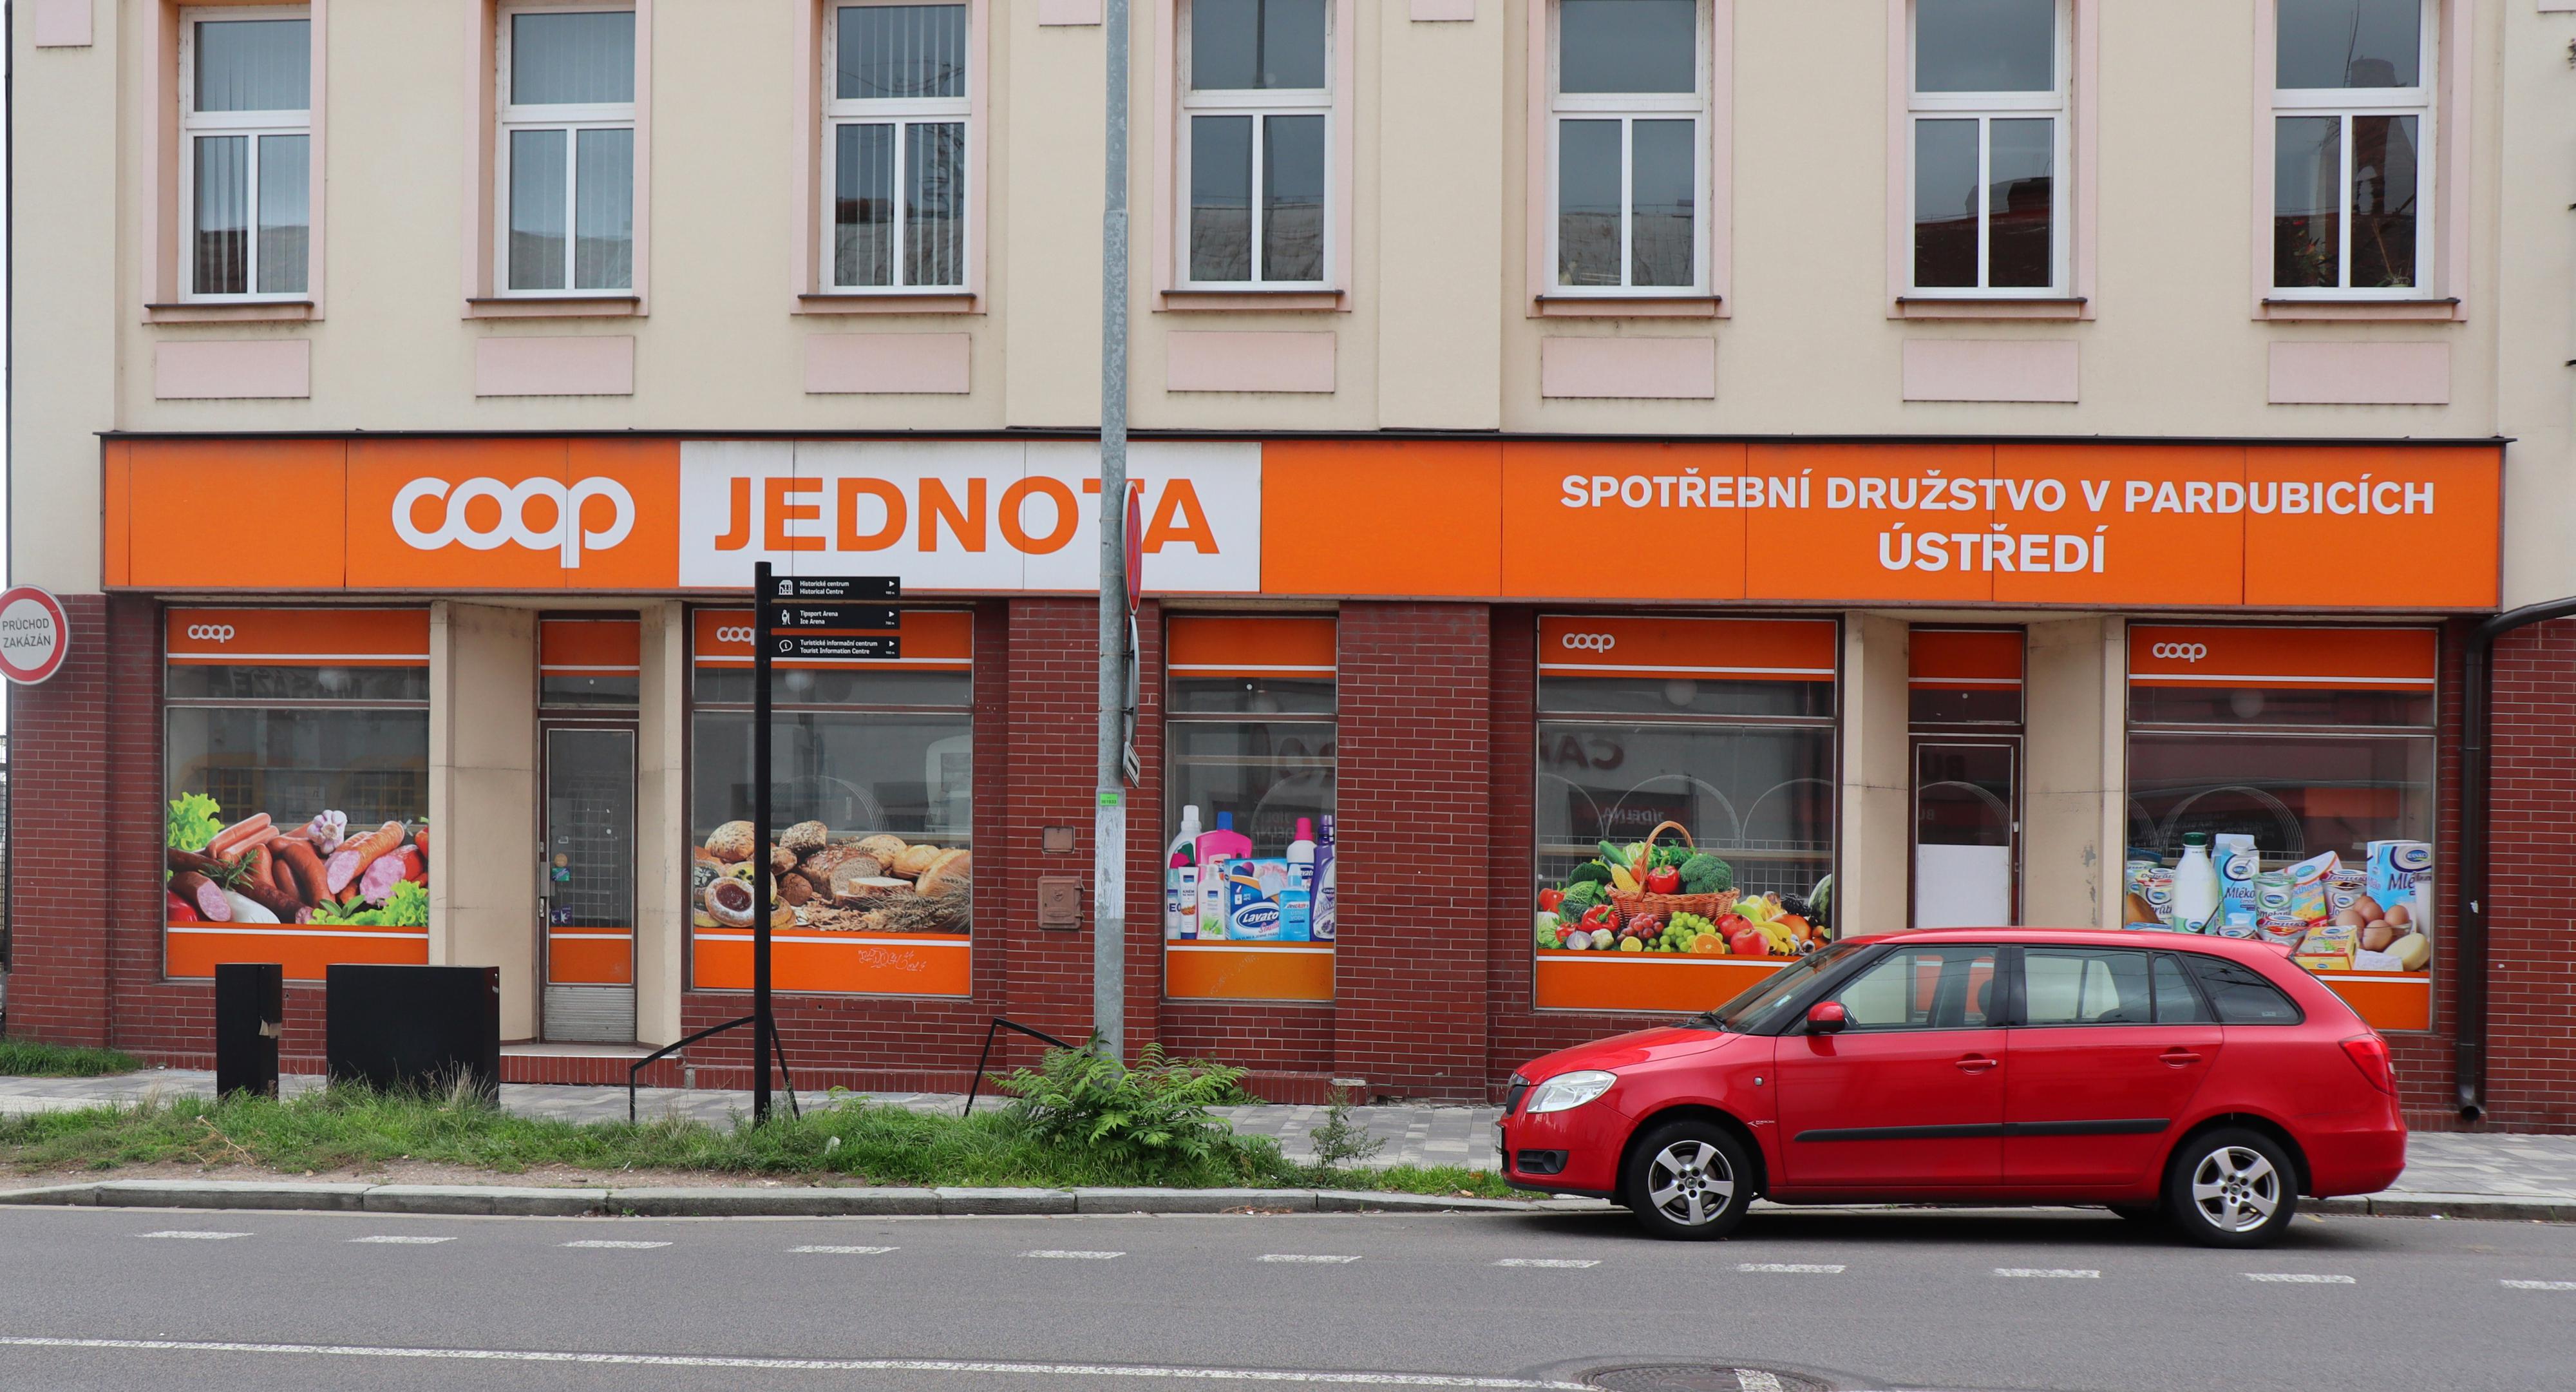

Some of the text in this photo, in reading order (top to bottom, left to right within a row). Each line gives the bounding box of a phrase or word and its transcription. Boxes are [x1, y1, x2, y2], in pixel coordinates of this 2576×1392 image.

[1560, 468, 2434, 515] SPOTŘEBNÍ DRUŽSTVO V PARDUBICÍCH
[392, 477, 636, 568] coop
[1879, 522, 2108, 573] ÚSTŘEDÍ
[3, 618, 50, 631] PRŮCHOD
[187, 624, 235, 643] coop
[3, 633, 52, 648] ZAKÁZÁN
[1562, 633, 1615, 653] coop
[2152, 642, 2207, 663] coop
[1242, 910, 1280, 923] Lavato
